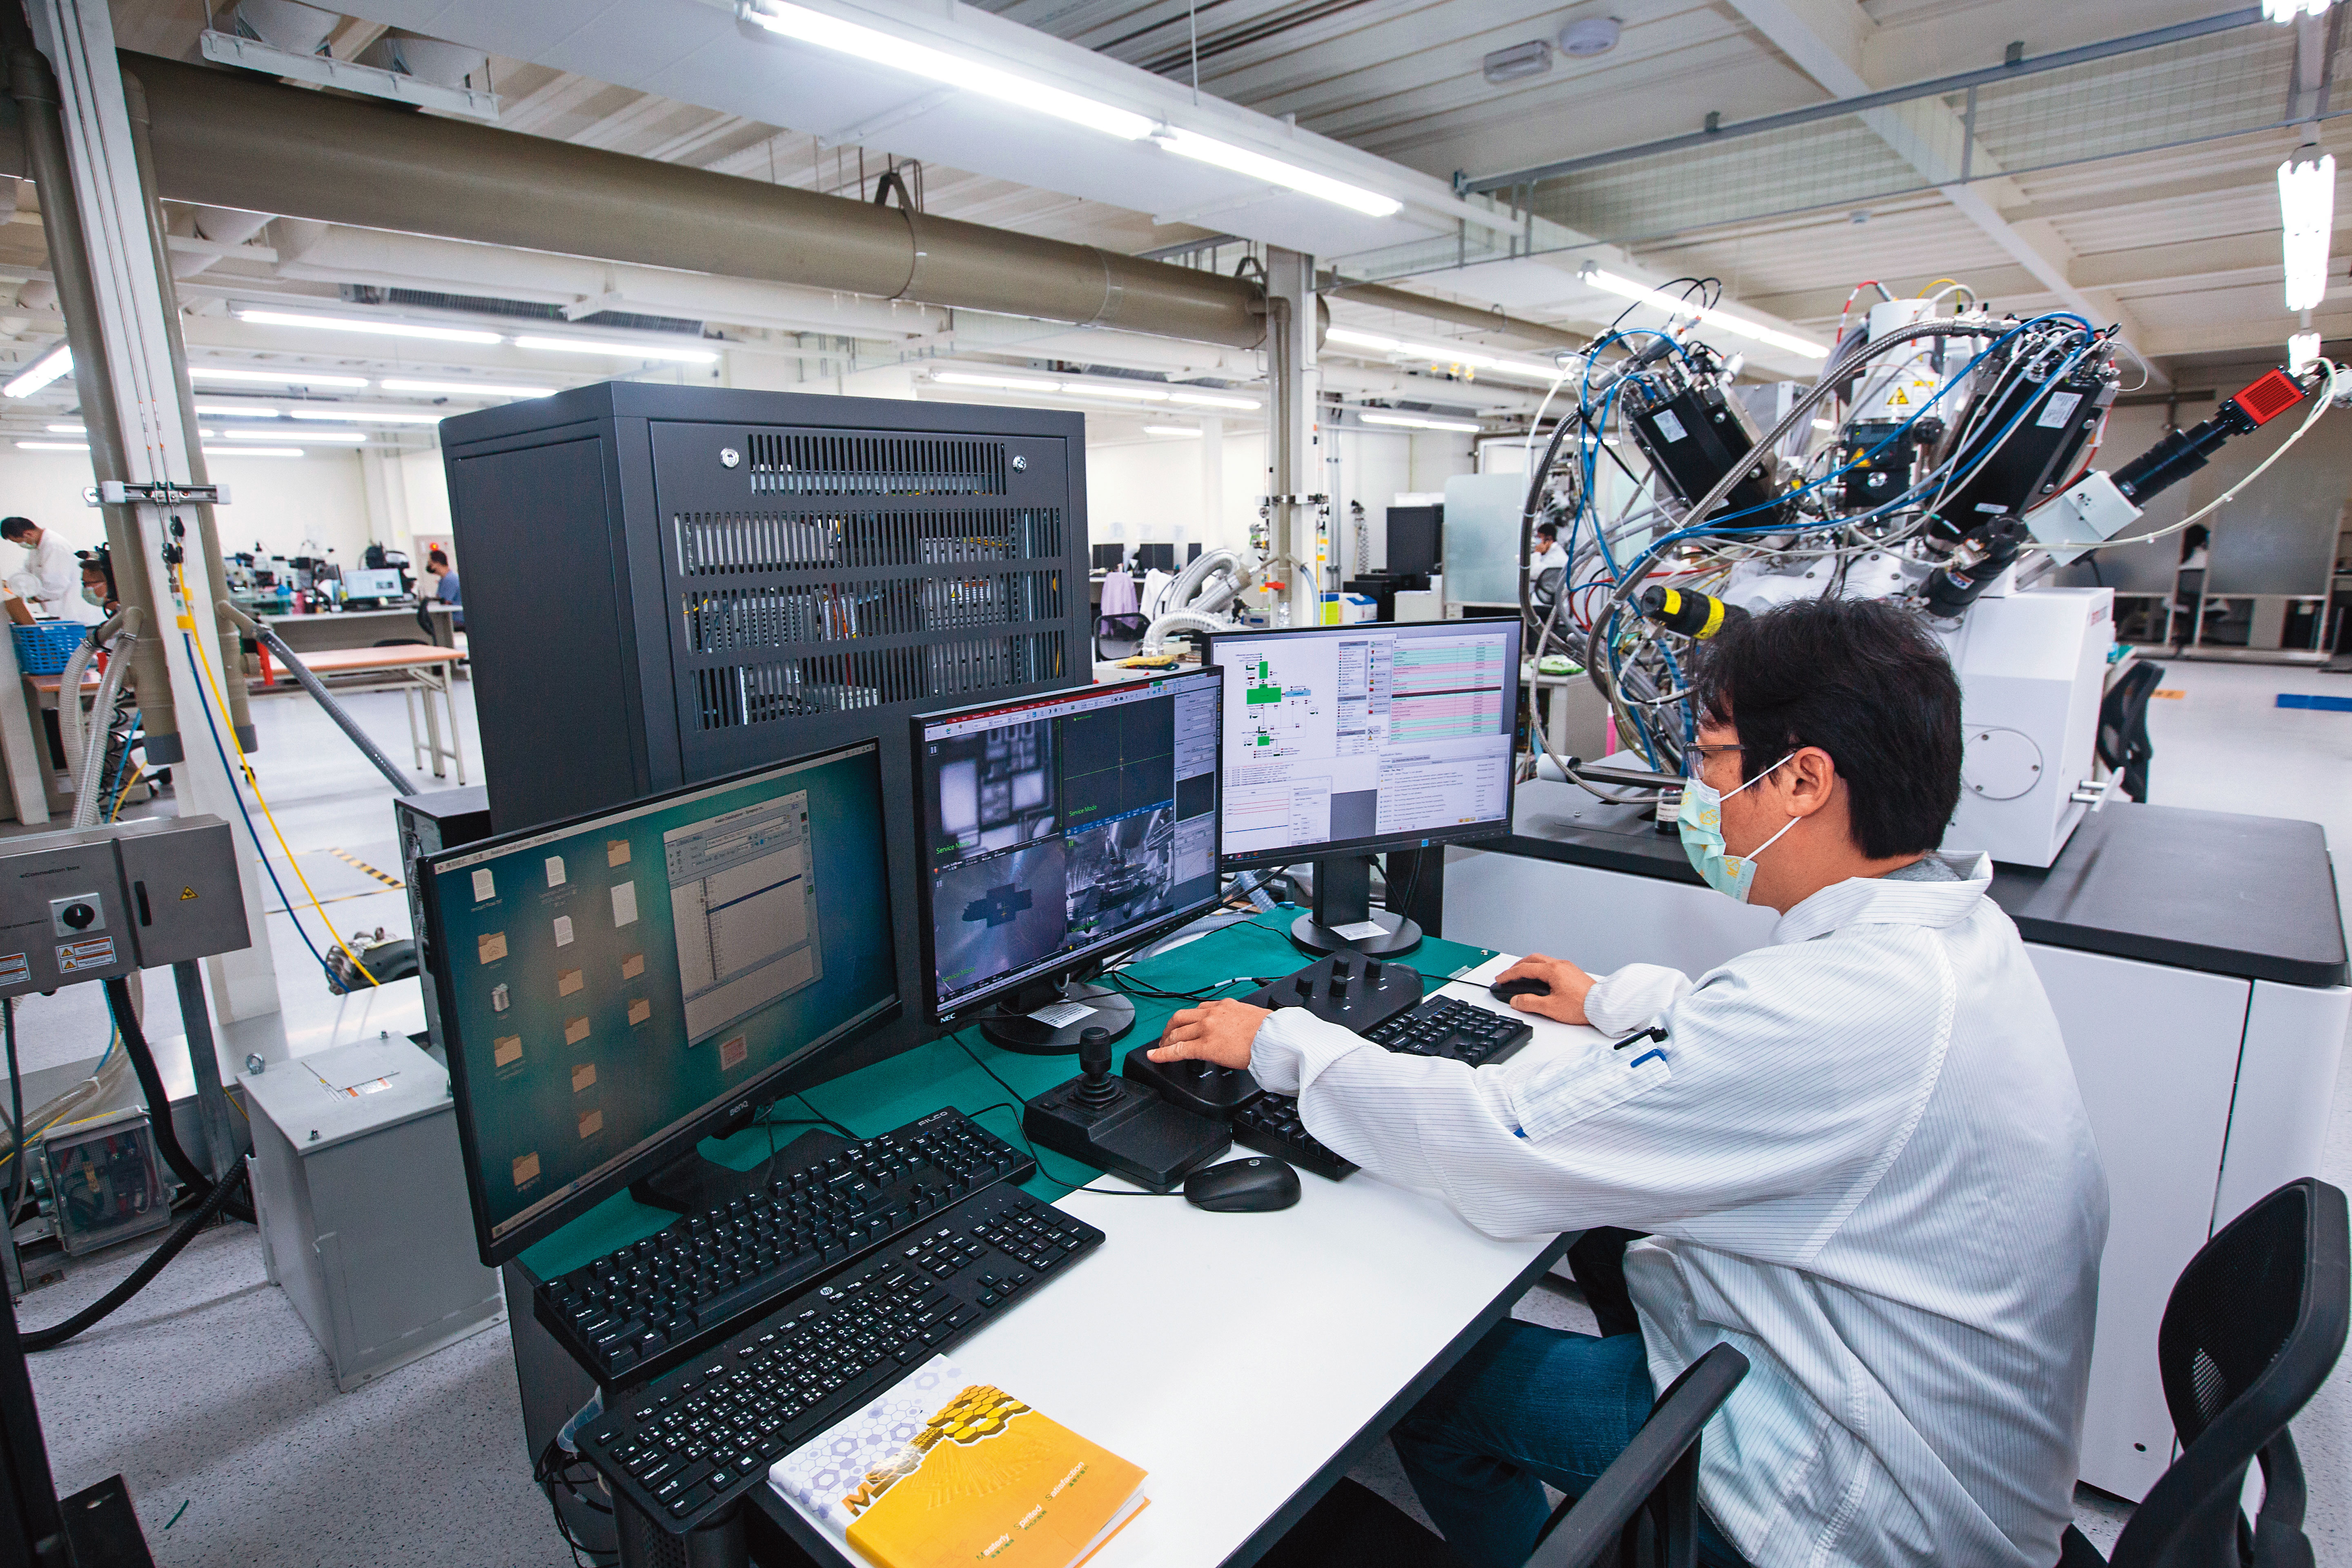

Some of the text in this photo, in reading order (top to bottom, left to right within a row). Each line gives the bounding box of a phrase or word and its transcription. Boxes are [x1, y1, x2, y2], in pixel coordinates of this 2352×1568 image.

[1069, 808, 1084, 817] Service
[936, 845, 954, 855] Service
[940, 1013, 956, 1023] NEC
[729, 1100, 749, 1116] BenQ
[918, 1111, 948, 1126] FILCO
[887, 1273, 905, 1285] Backspace
[657, 1463, 669, 1472] Lock
[1045, 1461, 1084, 1501] Satisfaction
[659, 1485, 671, 1494] Shift
[1013, 1504, 1042, 1530] Spirited
[976, 1533, 1009, 1561] Masterly
